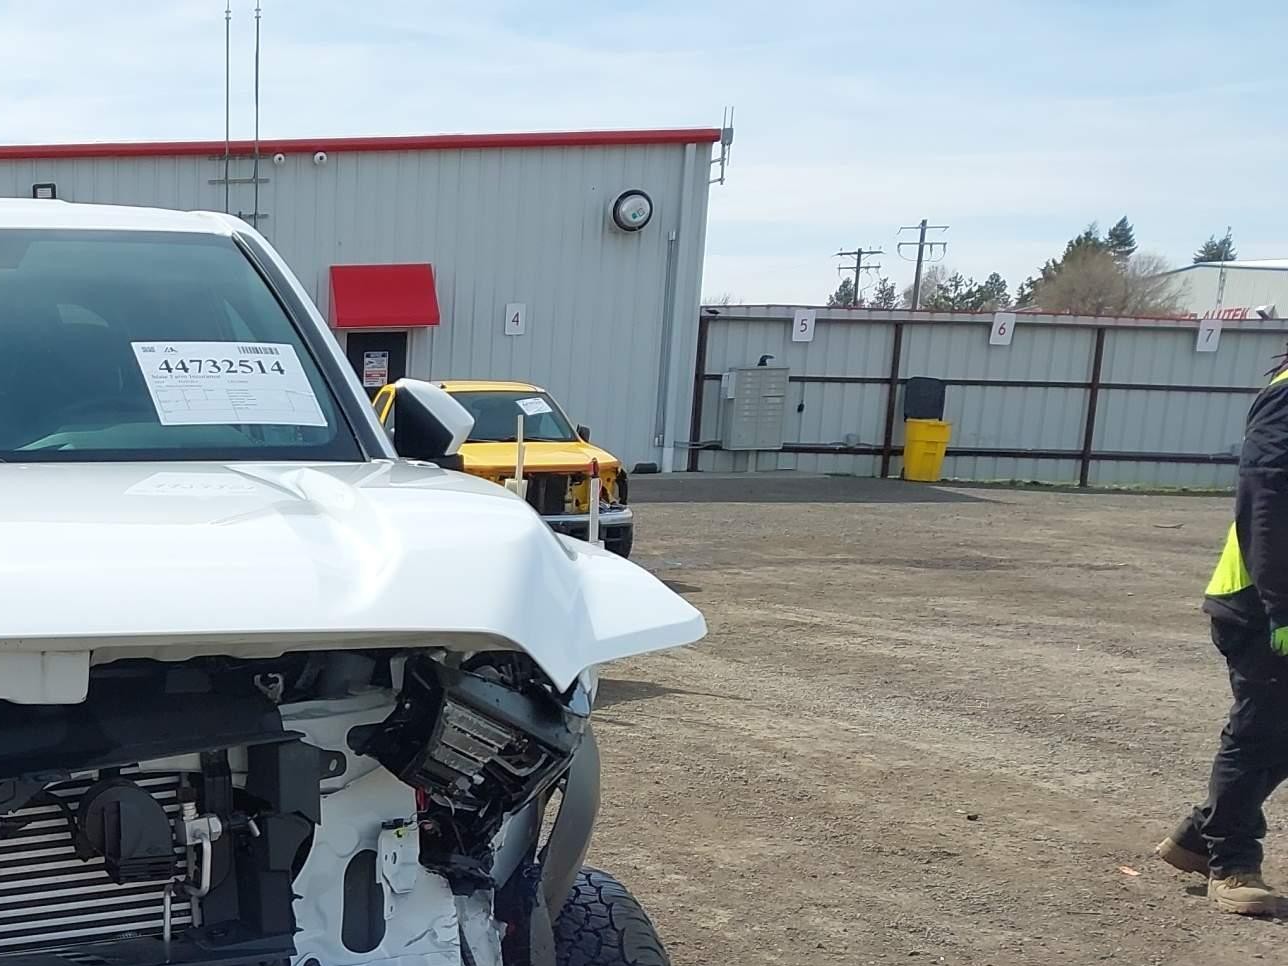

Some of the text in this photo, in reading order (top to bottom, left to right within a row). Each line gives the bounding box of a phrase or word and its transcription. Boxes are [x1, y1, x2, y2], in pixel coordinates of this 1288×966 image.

[511, 311, 520, 326] 4
[799, 318, 808, 333] 5
[998, 321, 1006, 336] 6
[1206, 328, 1214, 342] 7
[158, 359, 285, 375] 44732514
